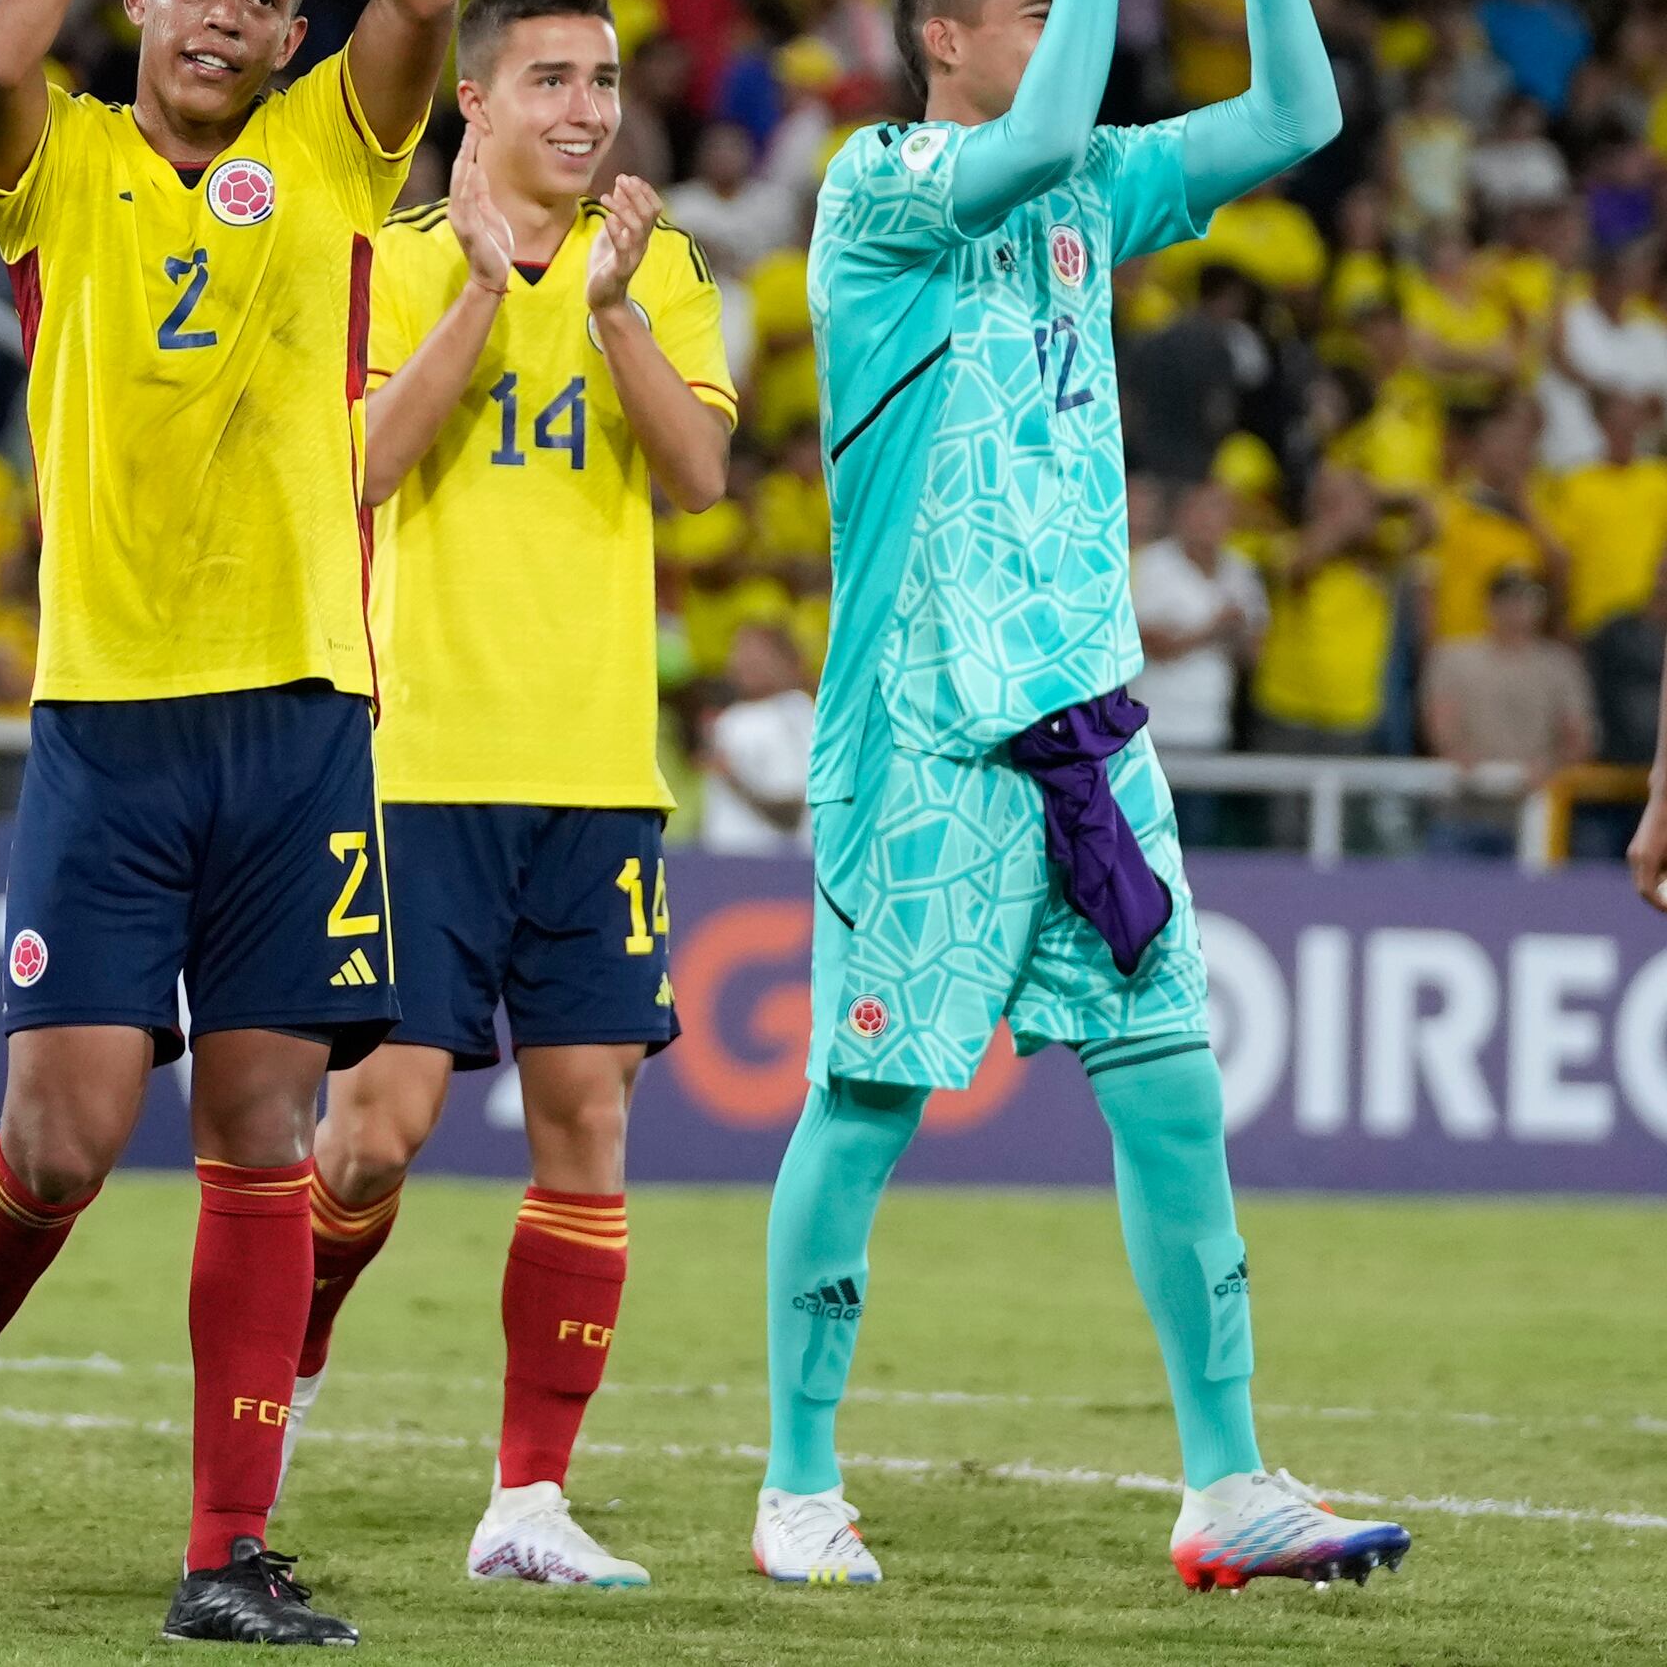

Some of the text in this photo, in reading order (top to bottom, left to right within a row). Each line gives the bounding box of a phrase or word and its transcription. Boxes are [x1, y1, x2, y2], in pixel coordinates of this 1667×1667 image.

[158, 248, 218, 350] 2
[489, 371, 586, 470] 14
[327, 831, 380, 937] 2
[616, 857, 671, 955] 14
[557, 1319, 616, 1348] FCF
[233, 1396, 291, 1427] FCF
